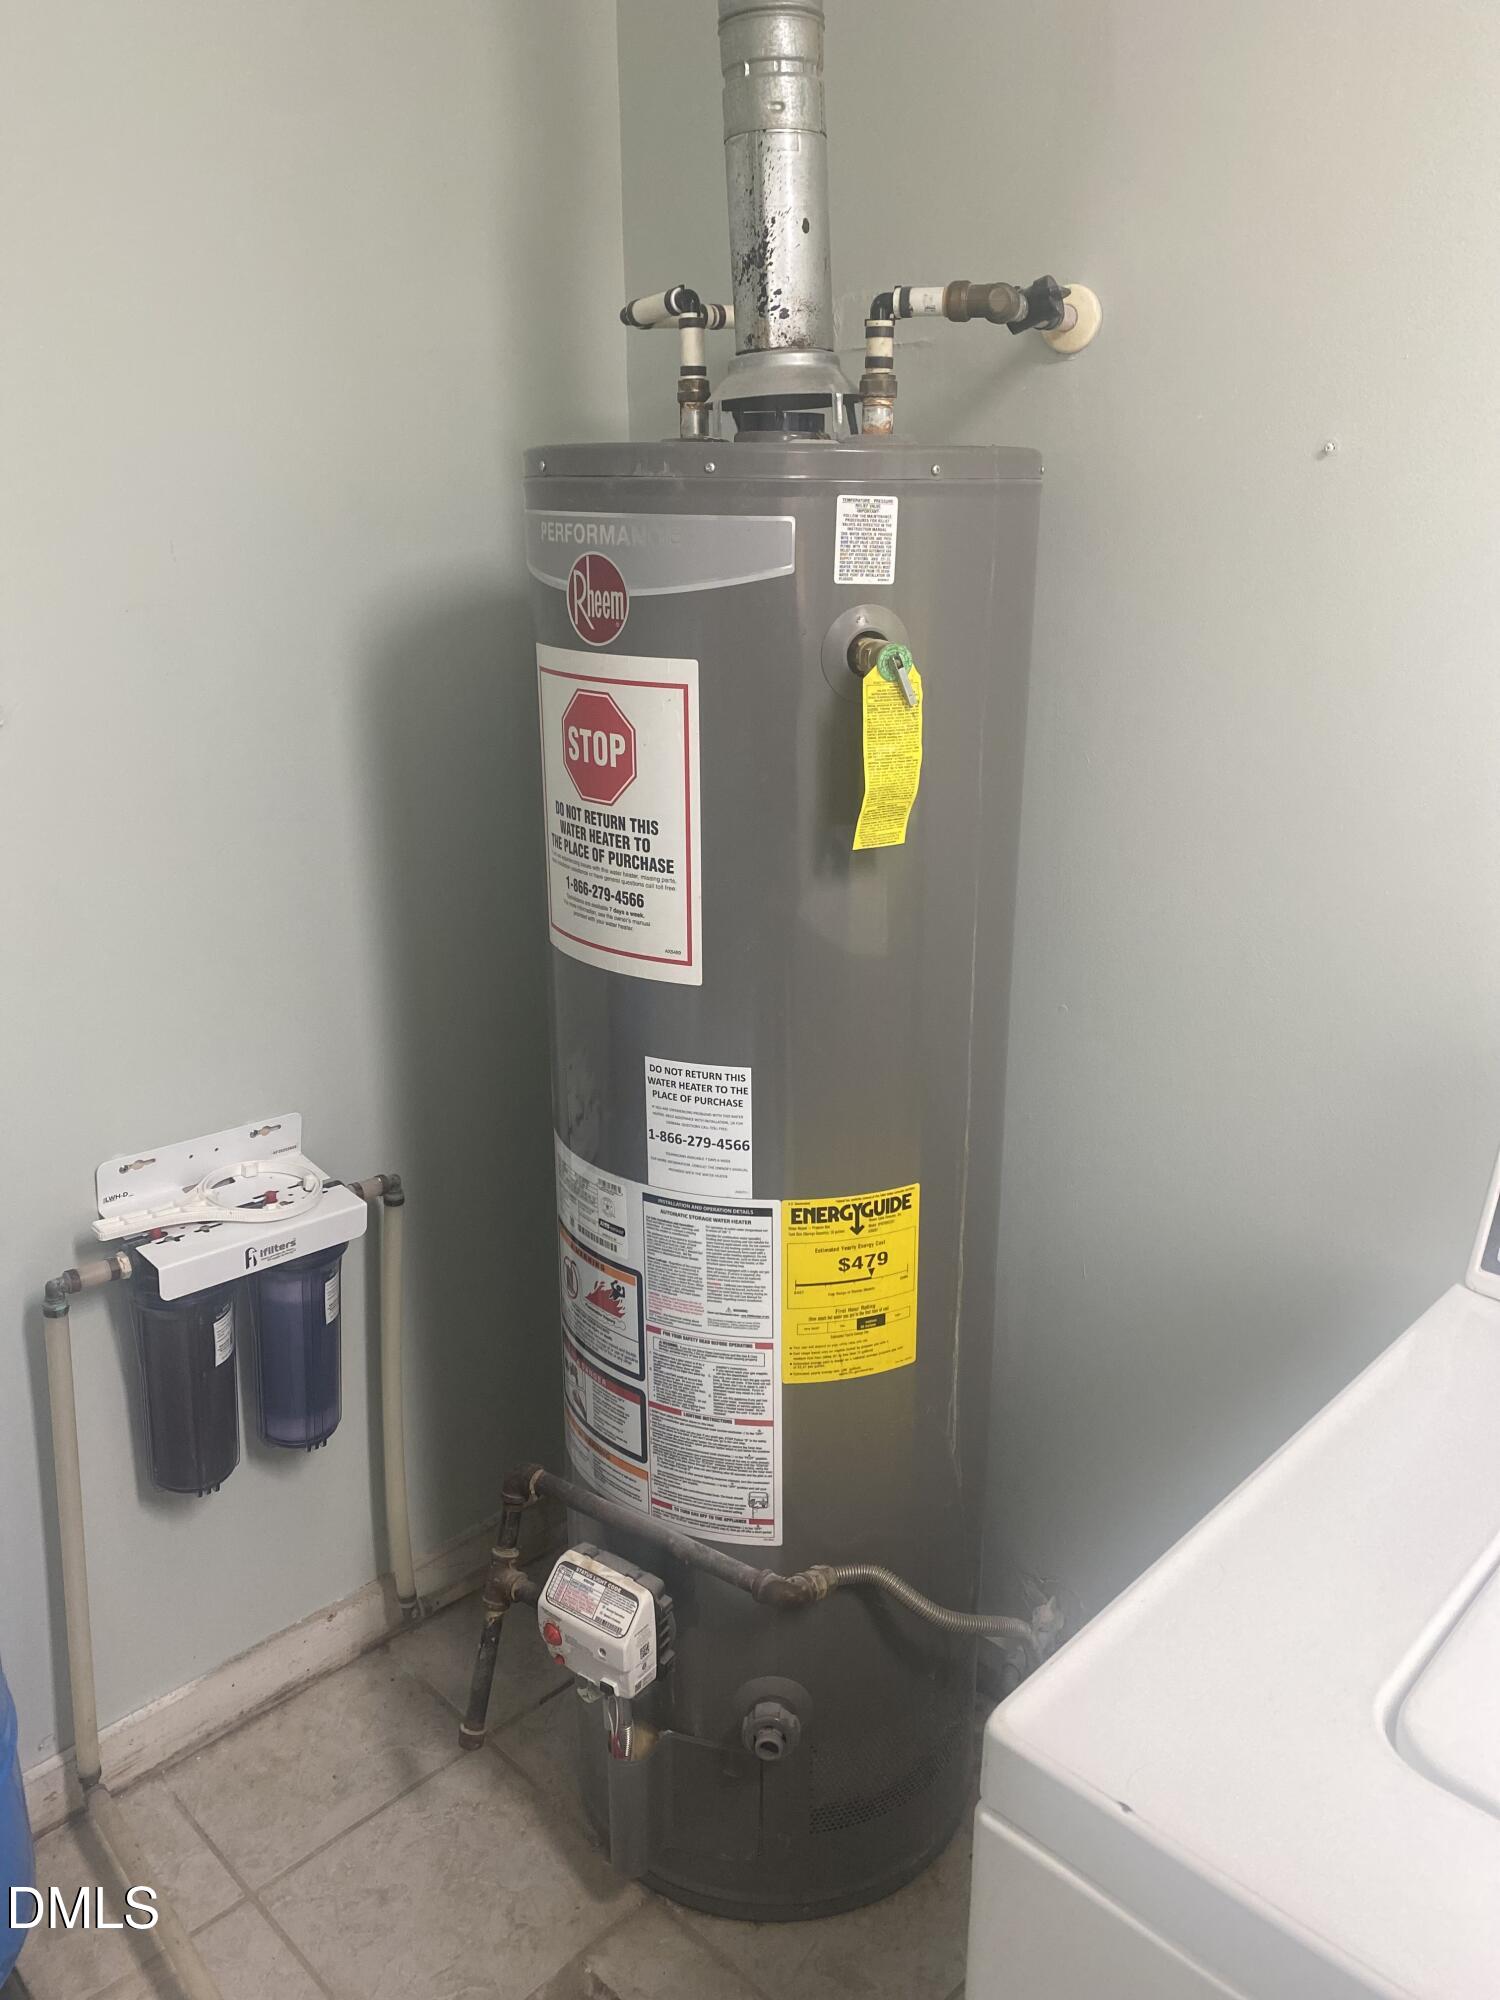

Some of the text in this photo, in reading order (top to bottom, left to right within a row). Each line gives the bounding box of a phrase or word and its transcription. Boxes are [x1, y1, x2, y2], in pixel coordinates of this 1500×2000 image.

[573, 555, 624, 630] Rheem
[567, 725, 626, 768] STOP
[555, 800, 659, 836] DO NOT RETURN THIS
[560, 819, 651, 853] WATER HEATER TO
[552, 832, 562, 850] THE
[564, 838, 589, 860] PLACE
[592, 847, 605, 863] OF
[608, 851, 675, 874] PURCHASE
[566, 876, 645, 908] 1-866-279-4566
[649, 1063, 746, 1083] DO NOT RETURN THIS
[647, 1076, 749, 1096] WATER HEATER TO THE
[652, 1089, 744, 1108] PLACE OF PURCHASE
[648, 1128, 750, 1152] 1-866-279-4566
[660, 1209, 688, 1219] AUTOMATIC
[689, 1214, 712, 1223] STORAGE
[703, 1206, 732, 1214] OPERATION
[791, 1193, 912, 1226] ENERGYGUIDE
[815, 1246, 840, 1254] Estimated
[838, 1251, 888, 1273] $479
[682, 1335, 698, 1343] SAFETY
[575, 1567, 622, 1593] STATUS LIGHT CODE
